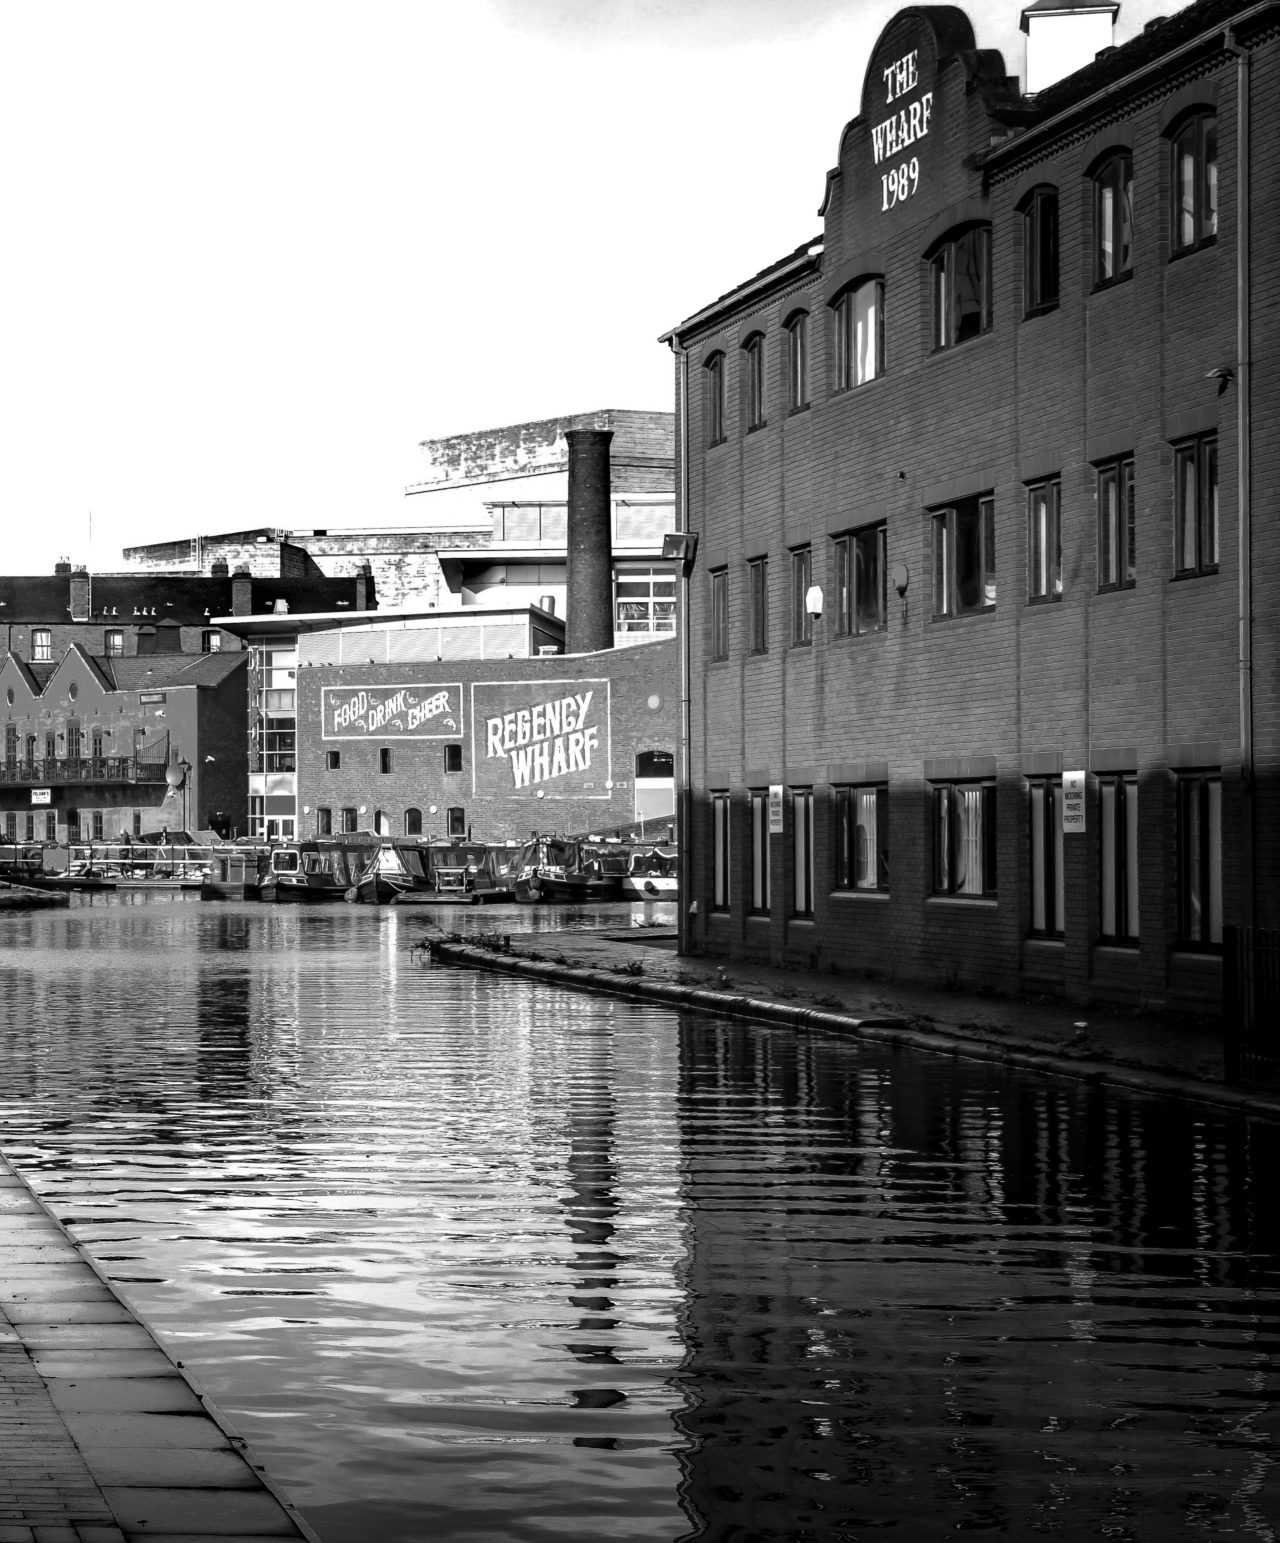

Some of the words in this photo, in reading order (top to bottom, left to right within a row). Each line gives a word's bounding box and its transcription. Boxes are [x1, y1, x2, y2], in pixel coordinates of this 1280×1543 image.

[883, 49, 918, 104] THE
[871, 91, 933, 165] WHARF
[881, 156, 919, 212] 1989
[334, 691, 367, 732] FOOD
[368, 690, 407, 732] DRINK
[407, 691, 452, 730] CHEER
[486, 690, 593, 758] REGENCY
[509, 725, 599, 789] WHARF
